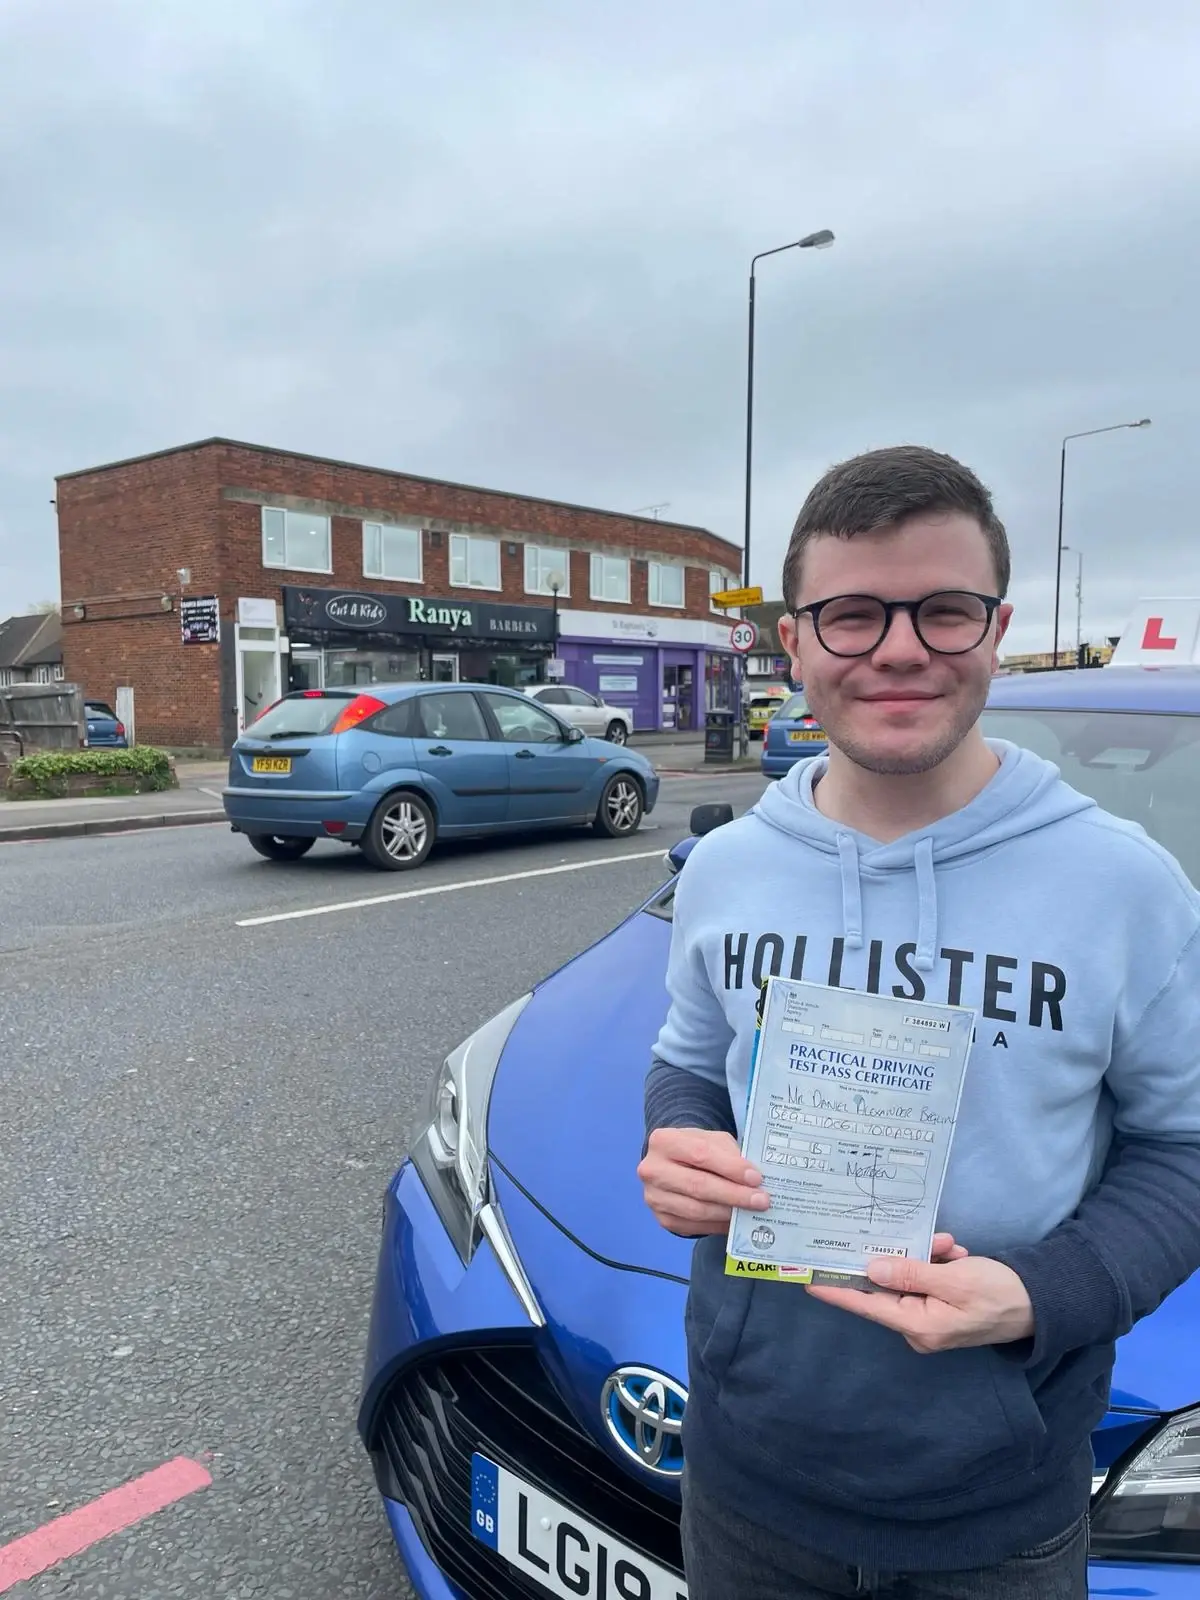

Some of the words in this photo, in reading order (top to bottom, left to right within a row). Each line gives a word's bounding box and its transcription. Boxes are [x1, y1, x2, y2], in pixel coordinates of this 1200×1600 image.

[330, 602, 347, 616] Cut
[360, 604, 384, 619] Kids
[408, 598, 472, 631] Ranya
[489, 618, 538, 633] BARBERS
[1141, 618, 1177, 650] L
[735, 630, 752, 644] 30
[256, 759, 272, 771] YF51
[724, 932, 1067, 1031] HOLLISTER
[790, 1043, 868, 1068] PRACTICAL
[872, 1058, 935, 1078] DRIVING
[789, 1057, 818, 1073] TEST
[821, 1064, 852, 1080] PASS
[855, 1070, 934, 1092] CERTIFICATE
[752, 1231, 775, 1244] DVSA
[813, 1238, 851, 1249] IMPORTANT
[736, 1260, 746, 1272] A
[476, 1508, 494, 1533] GB
